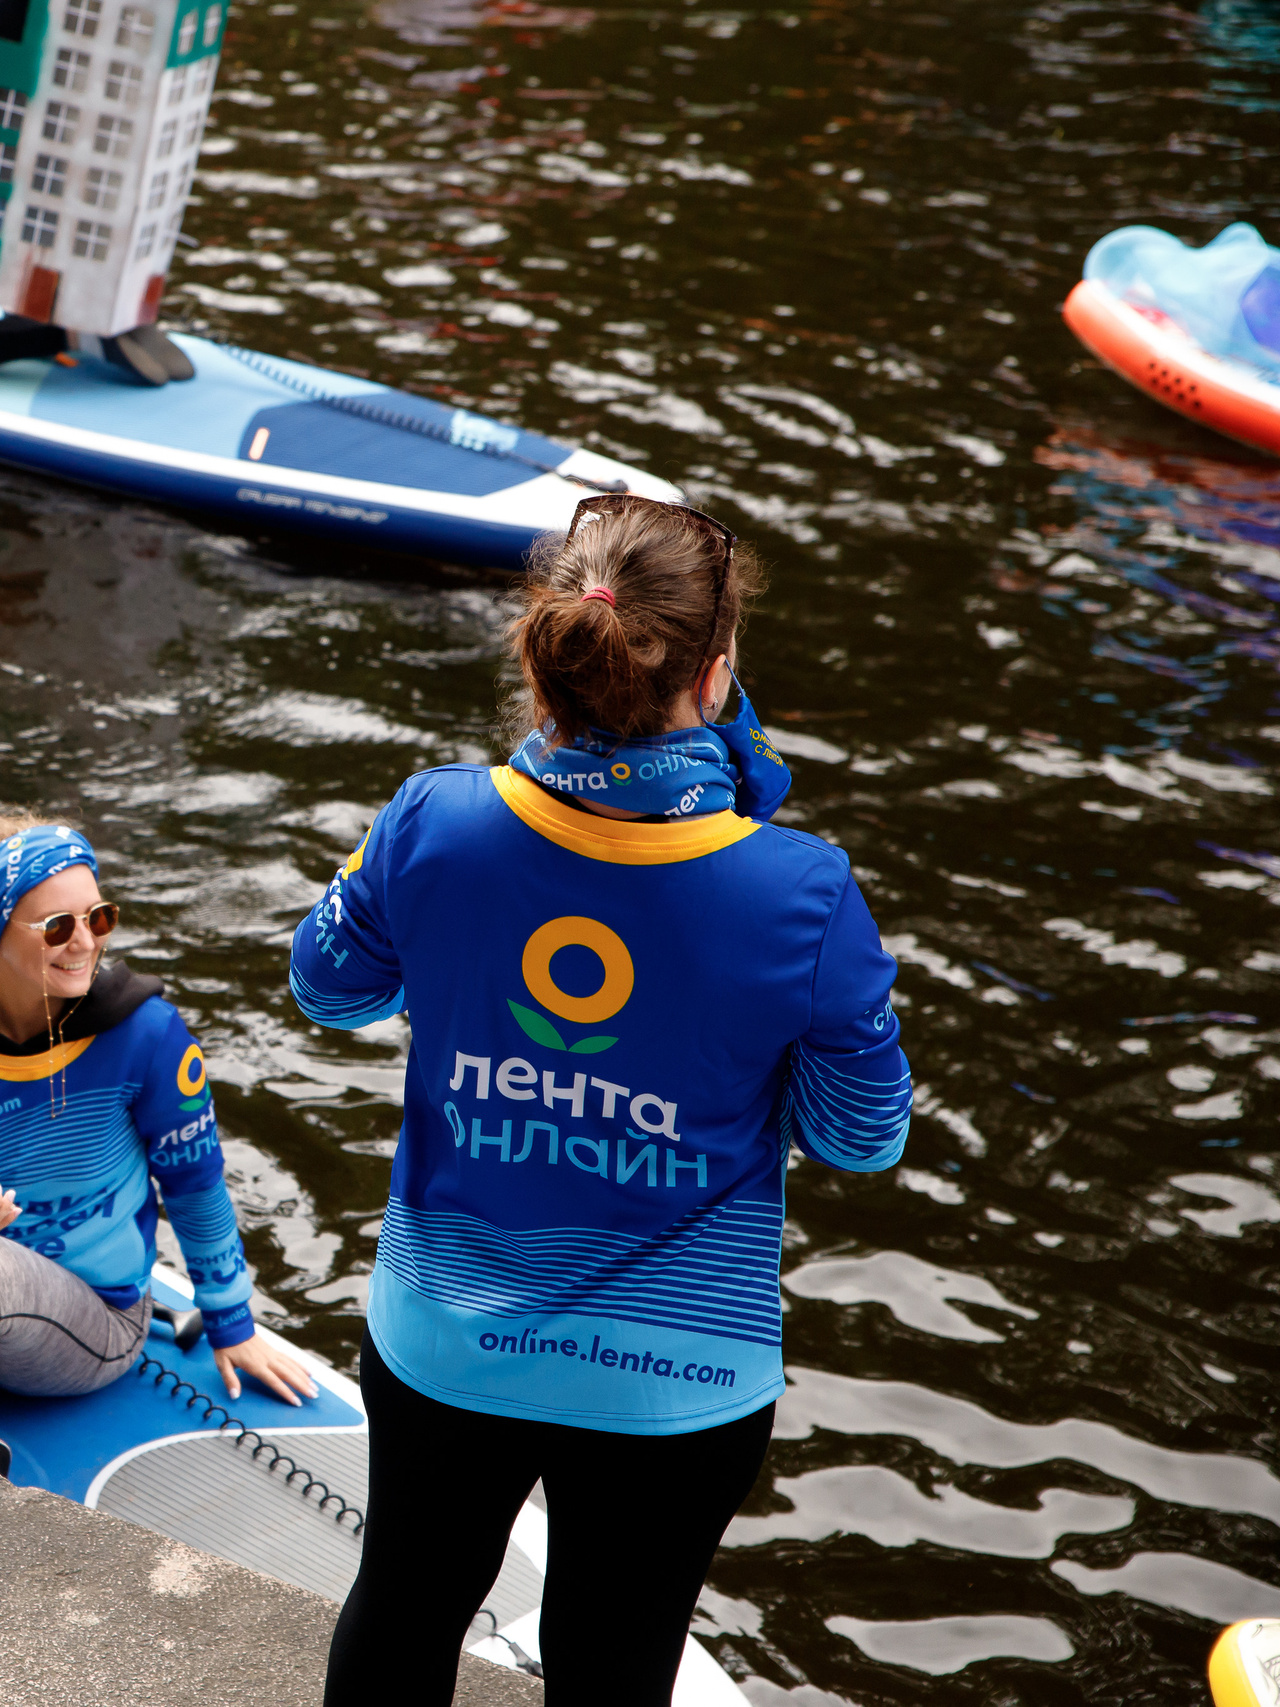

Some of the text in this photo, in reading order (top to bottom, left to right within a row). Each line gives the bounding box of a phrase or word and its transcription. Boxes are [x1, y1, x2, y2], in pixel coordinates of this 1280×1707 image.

[538, 771, 608, 792] ента
[664, 784, 705, 816] лен
[158, 1098, 216, 1149] лен
[449, 1050, 682, 1142] лента
[443, 1100, 708, 1189] онлайн
[478, 1326, 737, 1389] online.lenta.com
